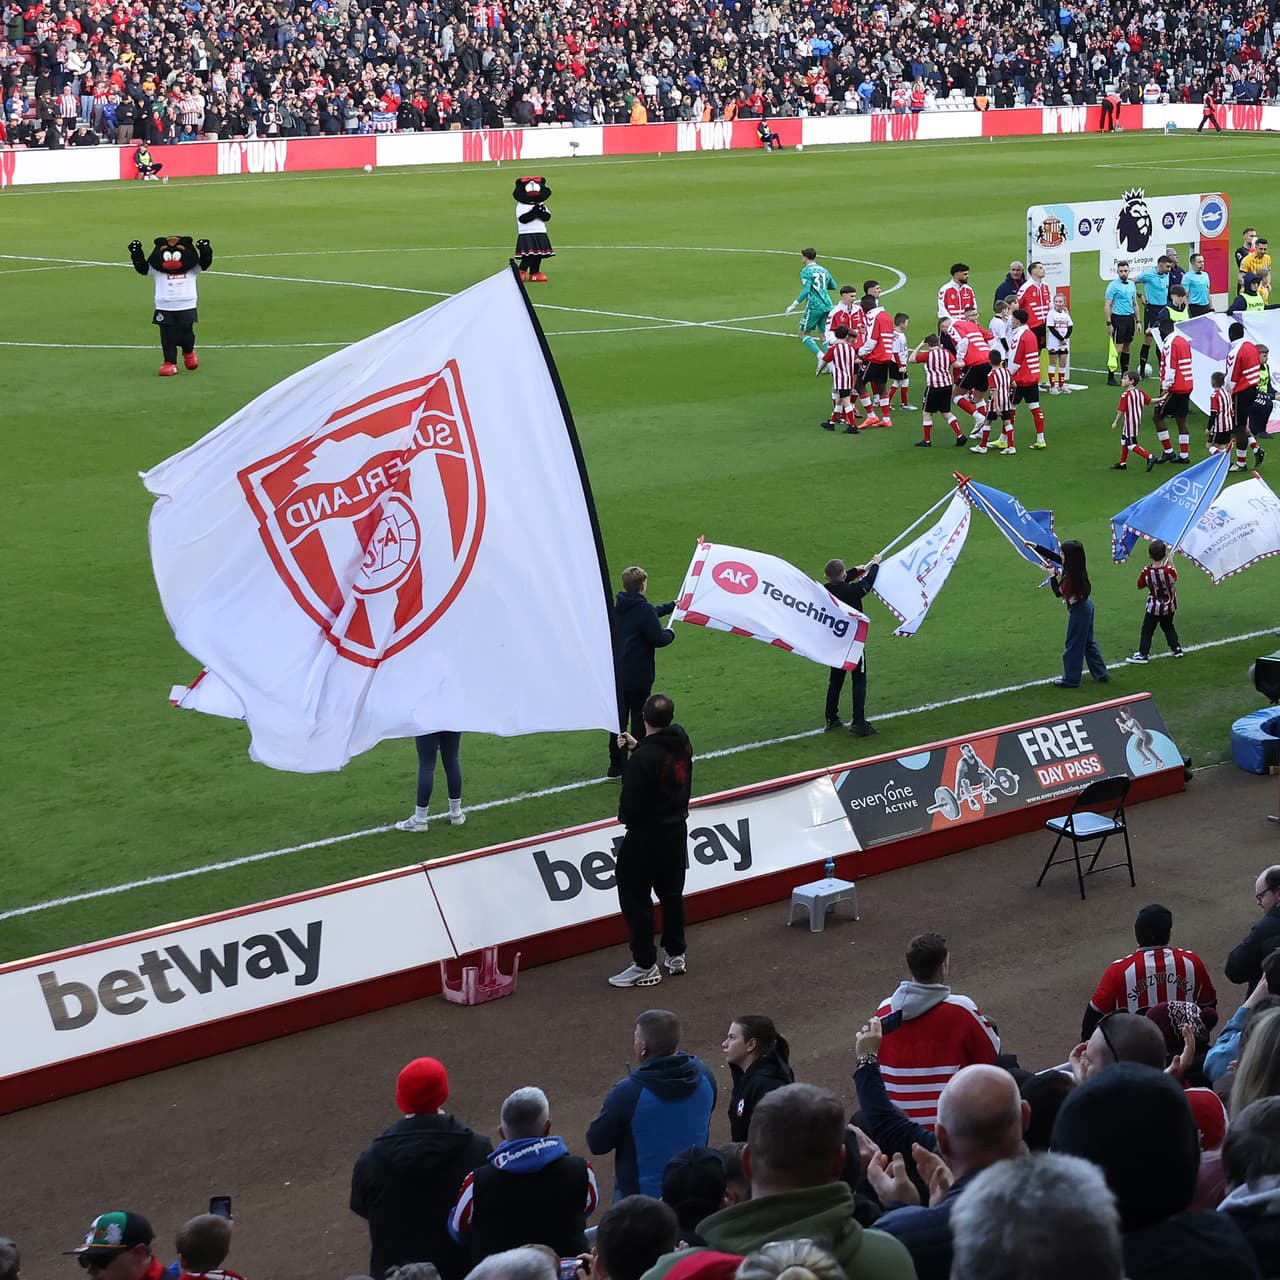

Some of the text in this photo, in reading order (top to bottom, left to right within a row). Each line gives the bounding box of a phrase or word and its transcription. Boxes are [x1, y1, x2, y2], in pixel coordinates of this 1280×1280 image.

[871, 113, 919, 143] HA'WAY
[1041, 106, 1087, 134] HA'WAY
[463, 129, 524, 162] HA'WAY
[676, 120, 733, 152] HA'WAY
[217, 139, 287, 175] HA'WAY
[1134, 257, 1153, 266] League
[813, 272, 826, 291] 31
[718, 568, 752, 588] AK
[762, 580, 850, 638] Teaching
[1017, 719, 1094, 767] FREE
[1036, 757, 1101, 786] DAY PASS
[851, 780, 914, 810] everyone
[885, 799, 919, 814] ACTIVE
[532, 817, 753, 903] beay
[37, 920, 324, 1032] betway
[495, 1138, 558, 1168] Champion
